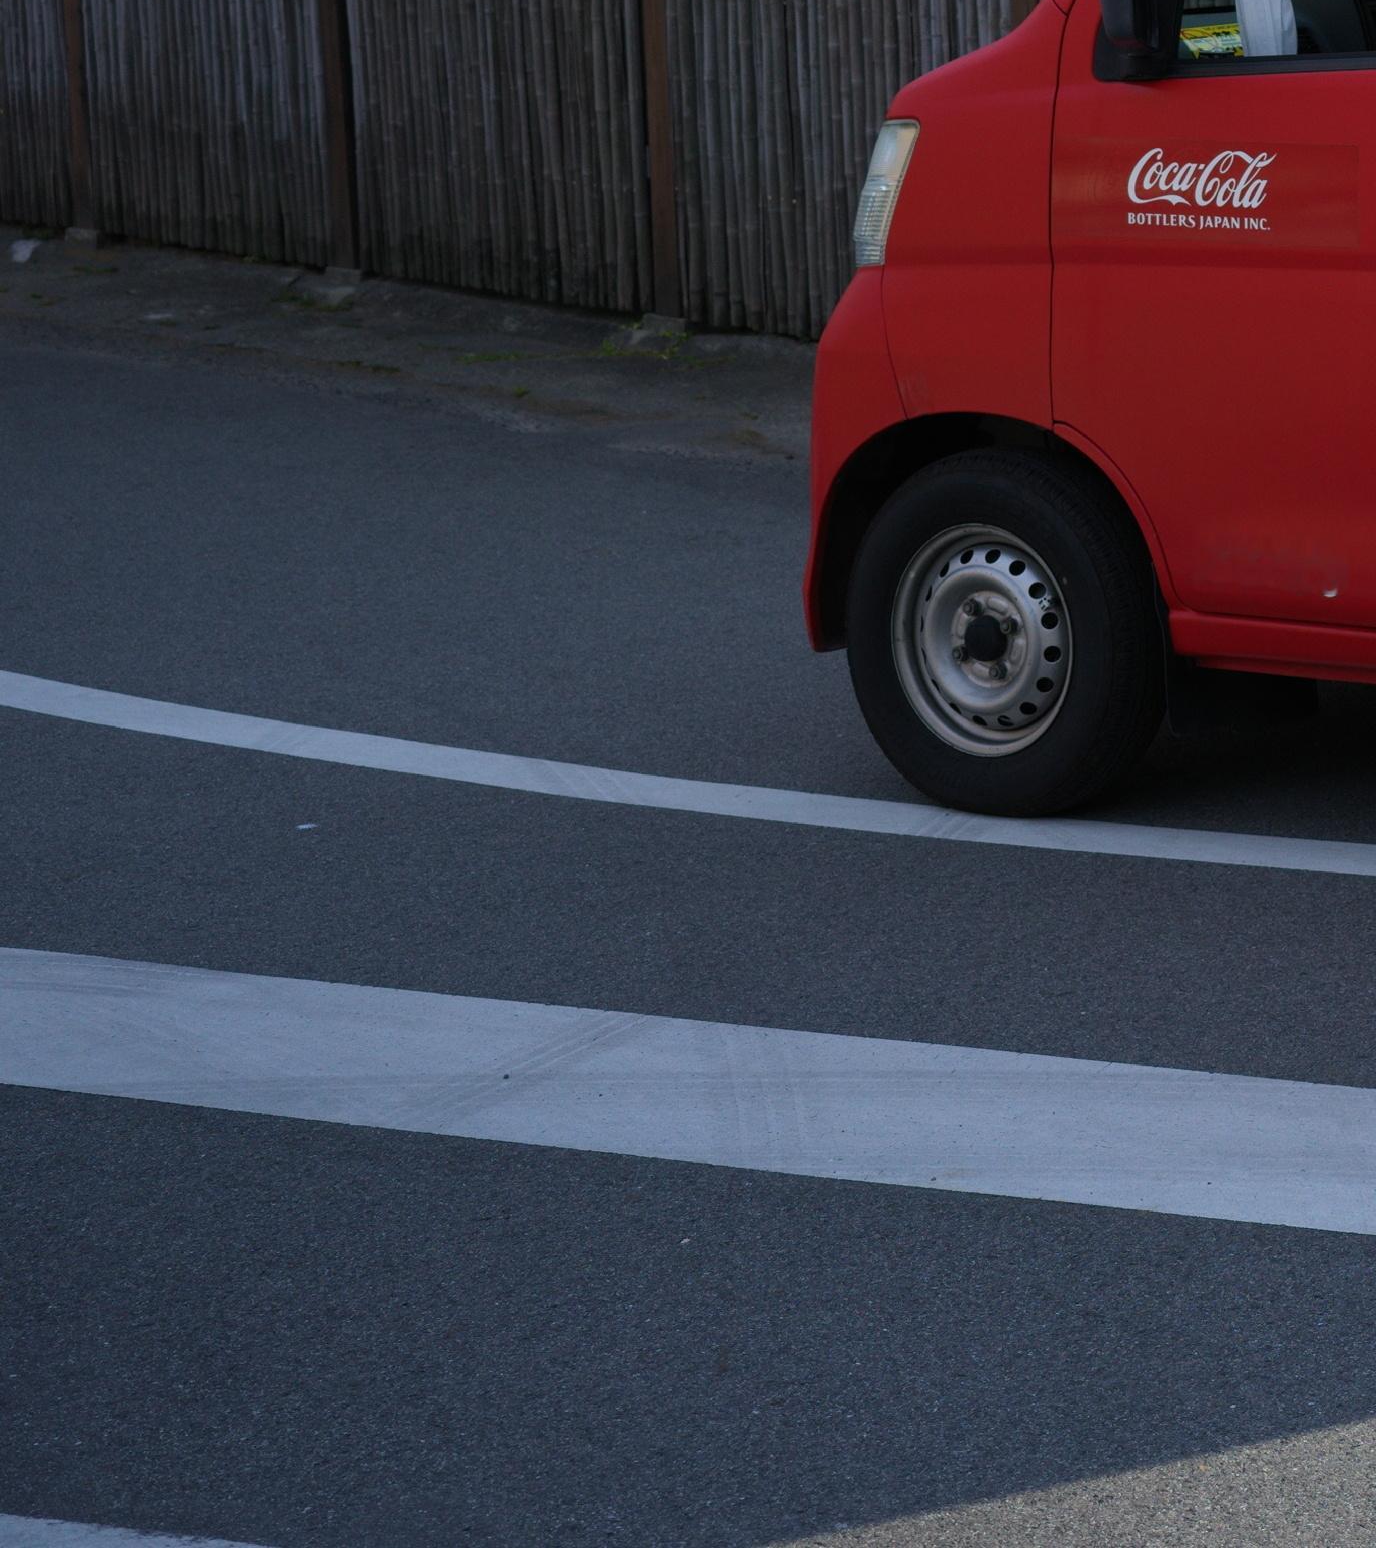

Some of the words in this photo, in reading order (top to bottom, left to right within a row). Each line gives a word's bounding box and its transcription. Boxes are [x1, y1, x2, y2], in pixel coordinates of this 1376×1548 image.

[1127, 147, 1277, 209] Coca-Cola
[1127, 212, 1196, 228] BOTTLERS
[1199, 215, 1241, 230] JAPAN
[1244, 217, 1271, 231] INC.
